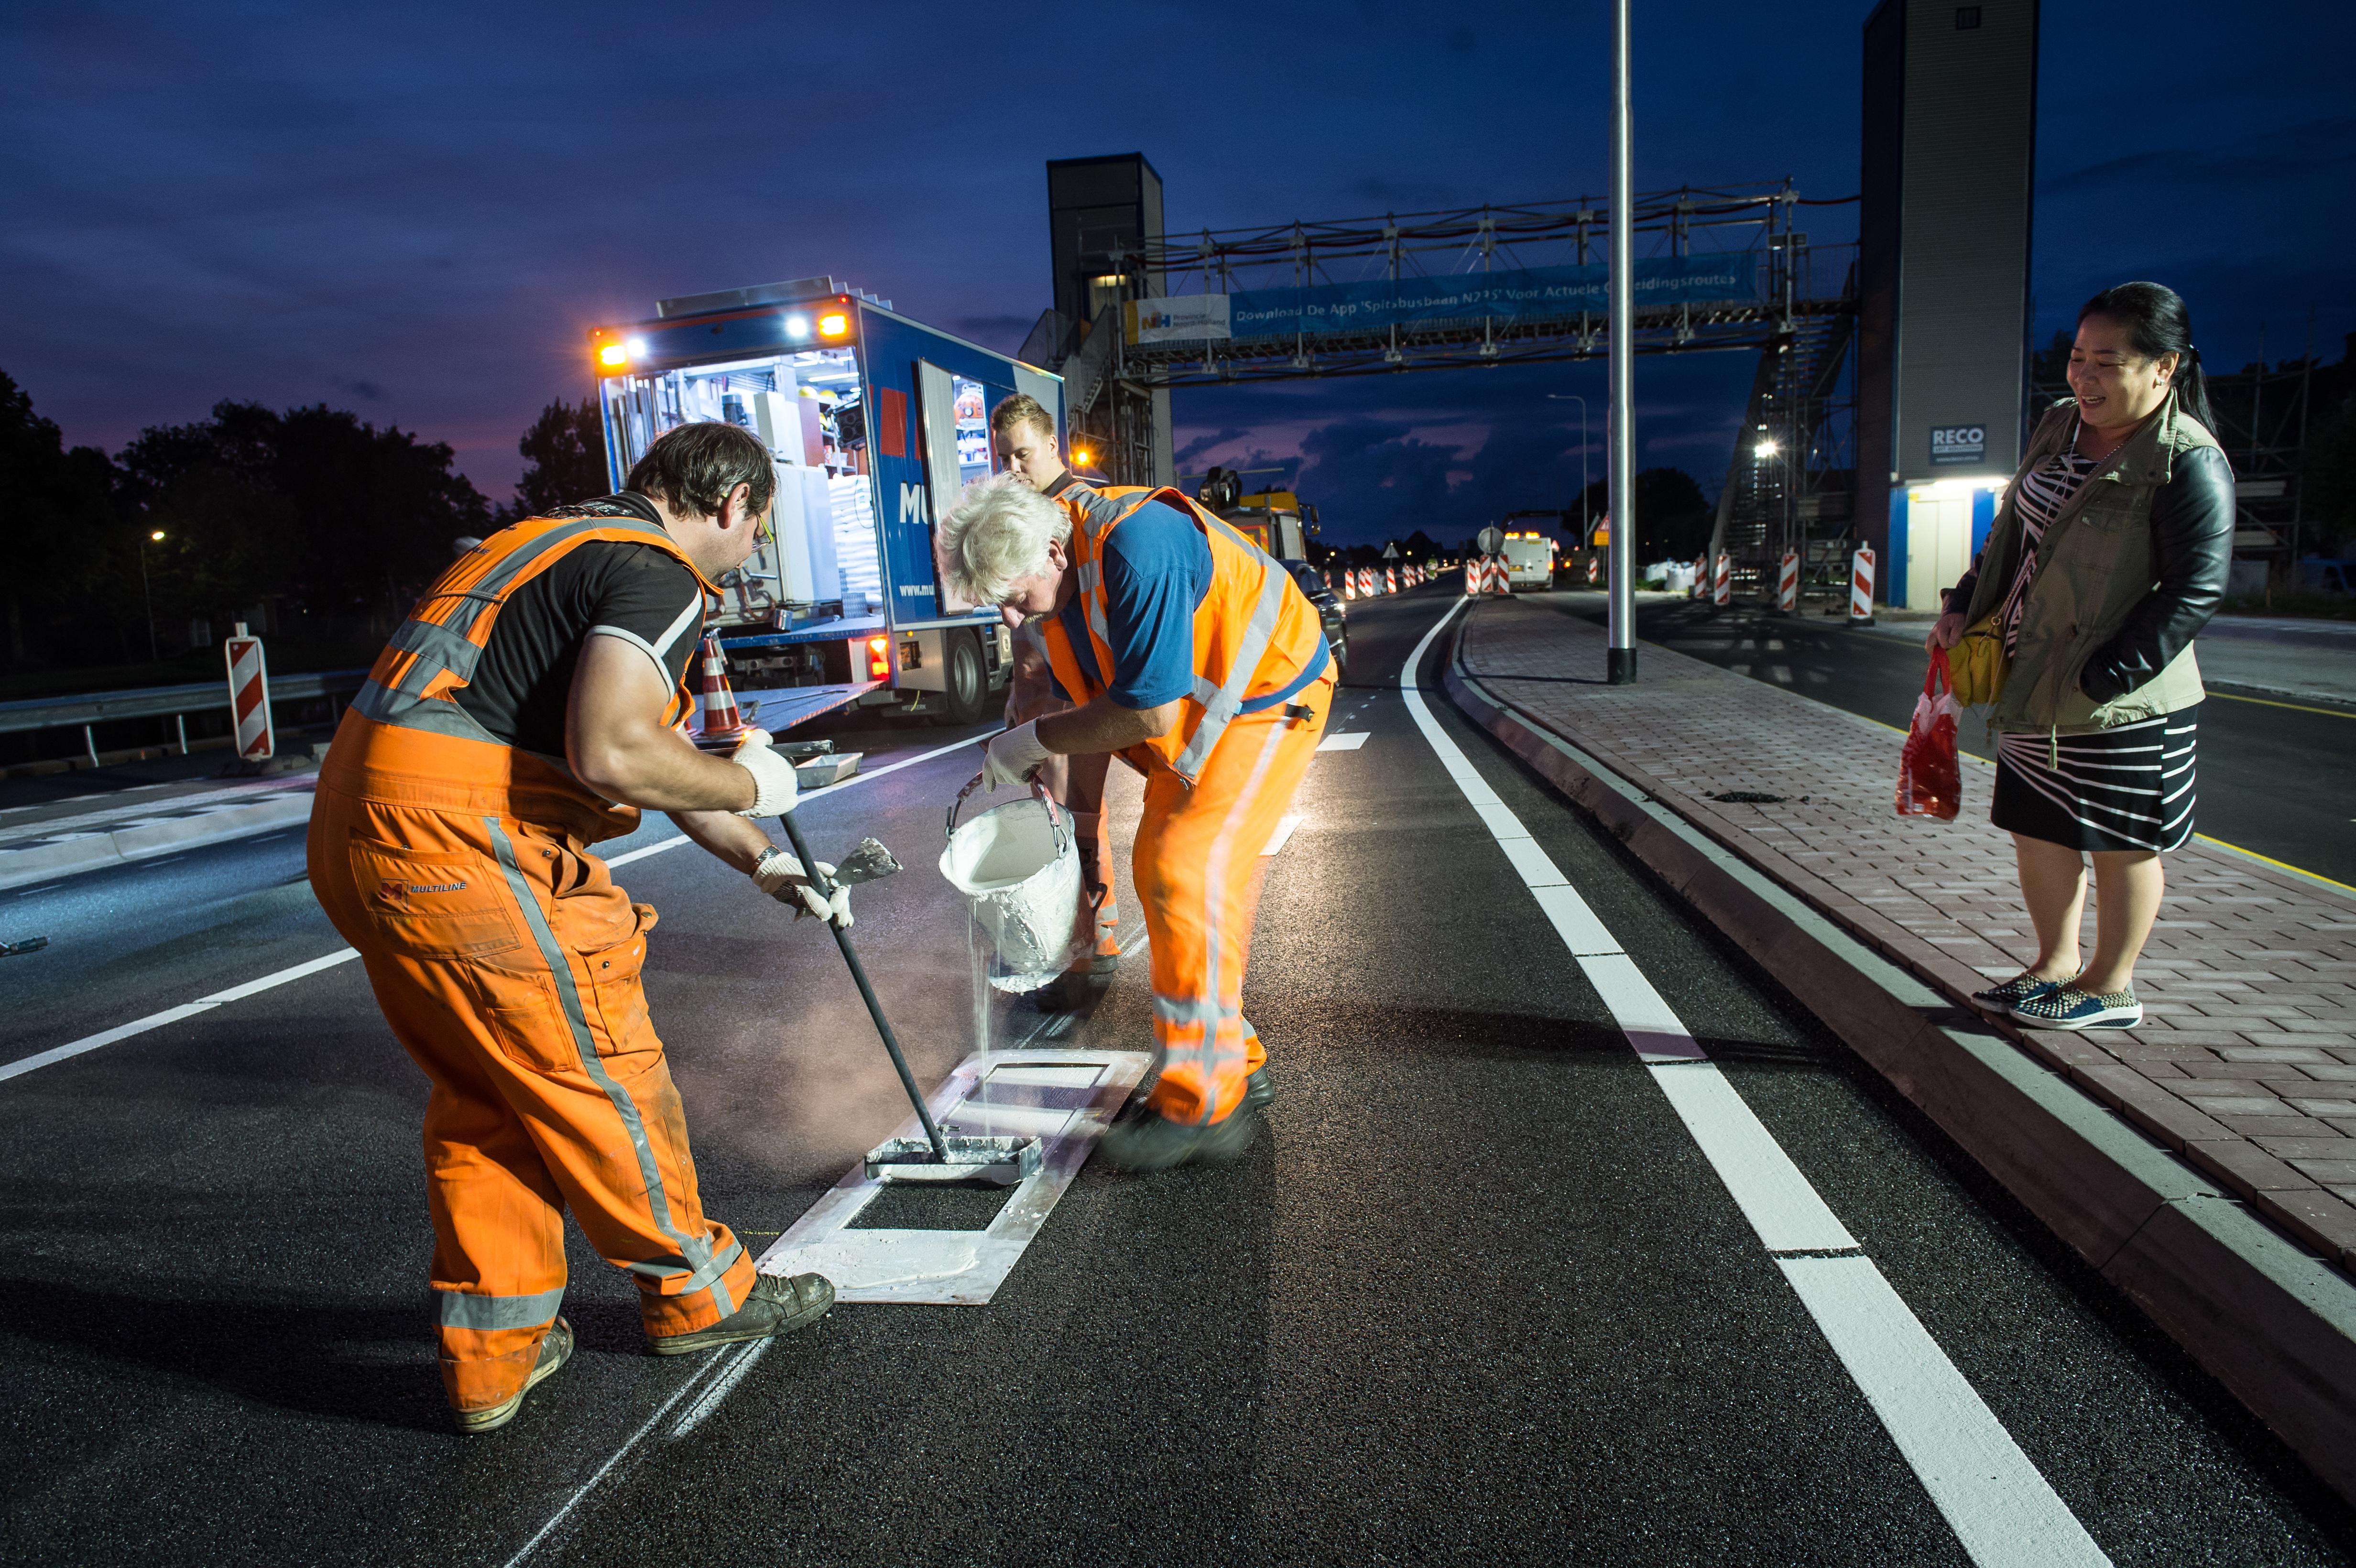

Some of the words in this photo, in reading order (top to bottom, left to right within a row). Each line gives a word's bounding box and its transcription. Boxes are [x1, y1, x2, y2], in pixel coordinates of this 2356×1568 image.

[1237, 305, 1302, 322] Download
[1307, 304, 1325, 316] De
[1331, 302, 1357, 316] App
[1506, 289, 1539, 300] Voor
[1544, 283, 1599, 297] Actuele
[1933, 427, 1984, 444] RECO
[411, 881, 467, 893] MULTILINE
